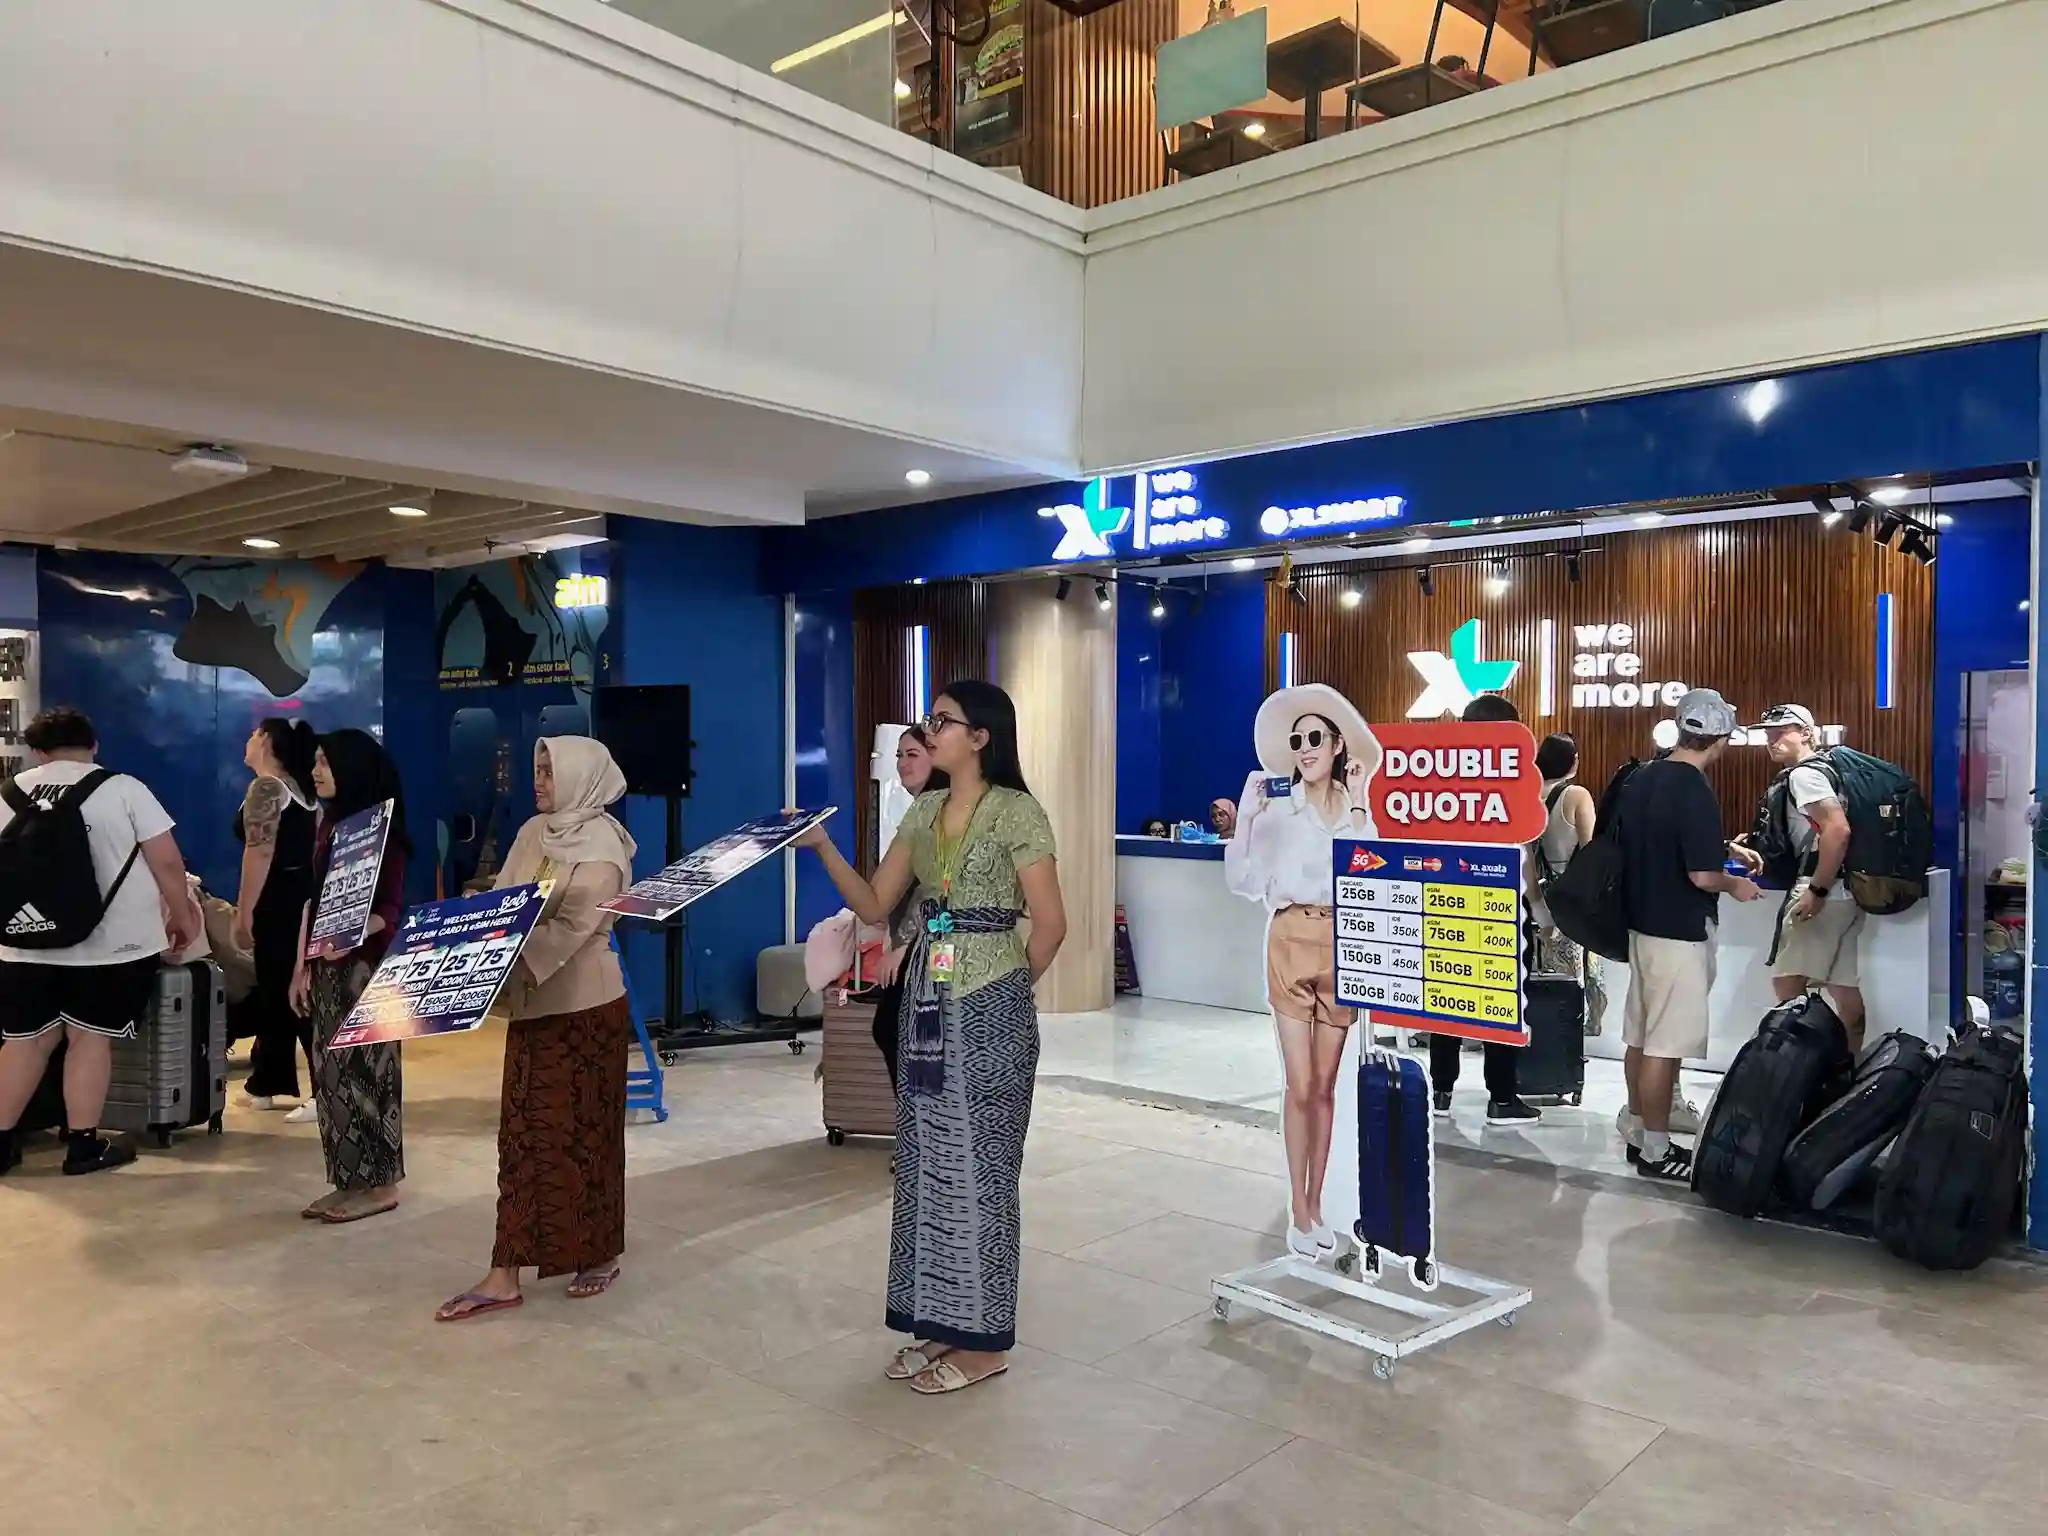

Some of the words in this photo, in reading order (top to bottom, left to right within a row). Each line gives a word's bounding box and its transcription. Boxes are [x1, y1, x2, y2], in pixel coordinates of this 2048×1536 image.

[1152, 470, 1197, 493] we
[1151, 496, 1202, 519] are
[1150, 516, 1230, 546] more
[1573, 623, 1633, 647] we
[507, 661, 513, 677] 2
[1573, 652, 1640, 677] are
[1572, 681, 1688, 708] more
[1385, 748, 1520, 778] DOUBLE
[29, 784, 71, 801] NIK
[1385, 791, 1508, 824] QUOTA
[1352, 854, 1369, 866] 5G
[1470, 863, 1480, 871] XL
[1481, 864, 1507, 873] axiata
[1342, 887, 1375, 901] 25GB
[1392, 893, 1418, 905] 250K
[1429, 894, 1465, 909] 25GB
[443, 910, 486, 926] WELCOME
[485, 909, 496, 917] TO
[497, 889, 529, 916] Bali
[1484, 901, 1513, 914] 300K
[5, 920, 57, 934] adidas
[405, 932, 423, 943] GET
[422, 929, 438, 939] SIM
[438, 925, 461, 936] CARD
[461, 923, 469, 932] &
[469, 920, 491, 931] eSIM
[1342, 918, 1375, 932] 75GB
[1392, 925, 1419, 937] 350K
[1430, 927, 1465, 942] 75GB
[1484, 936, 1513, 948] 400K
[441, 953, 471, 973] 25
[479, 947, 507, 967] 75
[1343, 950, 1382, 965] 150GB
[1392, 959, 1420, 970] 450K
[406, 960, 433, 979] 75
[472, 968, 503, 982] 400K
[1430, 960, 1472, 976] 150GB
[1485, 969, 1514, 982] 500K
[438, 975, 466, 987] 300K
[458, 988, 492, 1001] 300GB
[1343, 983, 1385, 999] 300GB
[1393, 992, 1420, 1005] 600K
[1430, 995, 1476, 1012] 300GB
[1485, 1005, 1514, 1018] 600K
